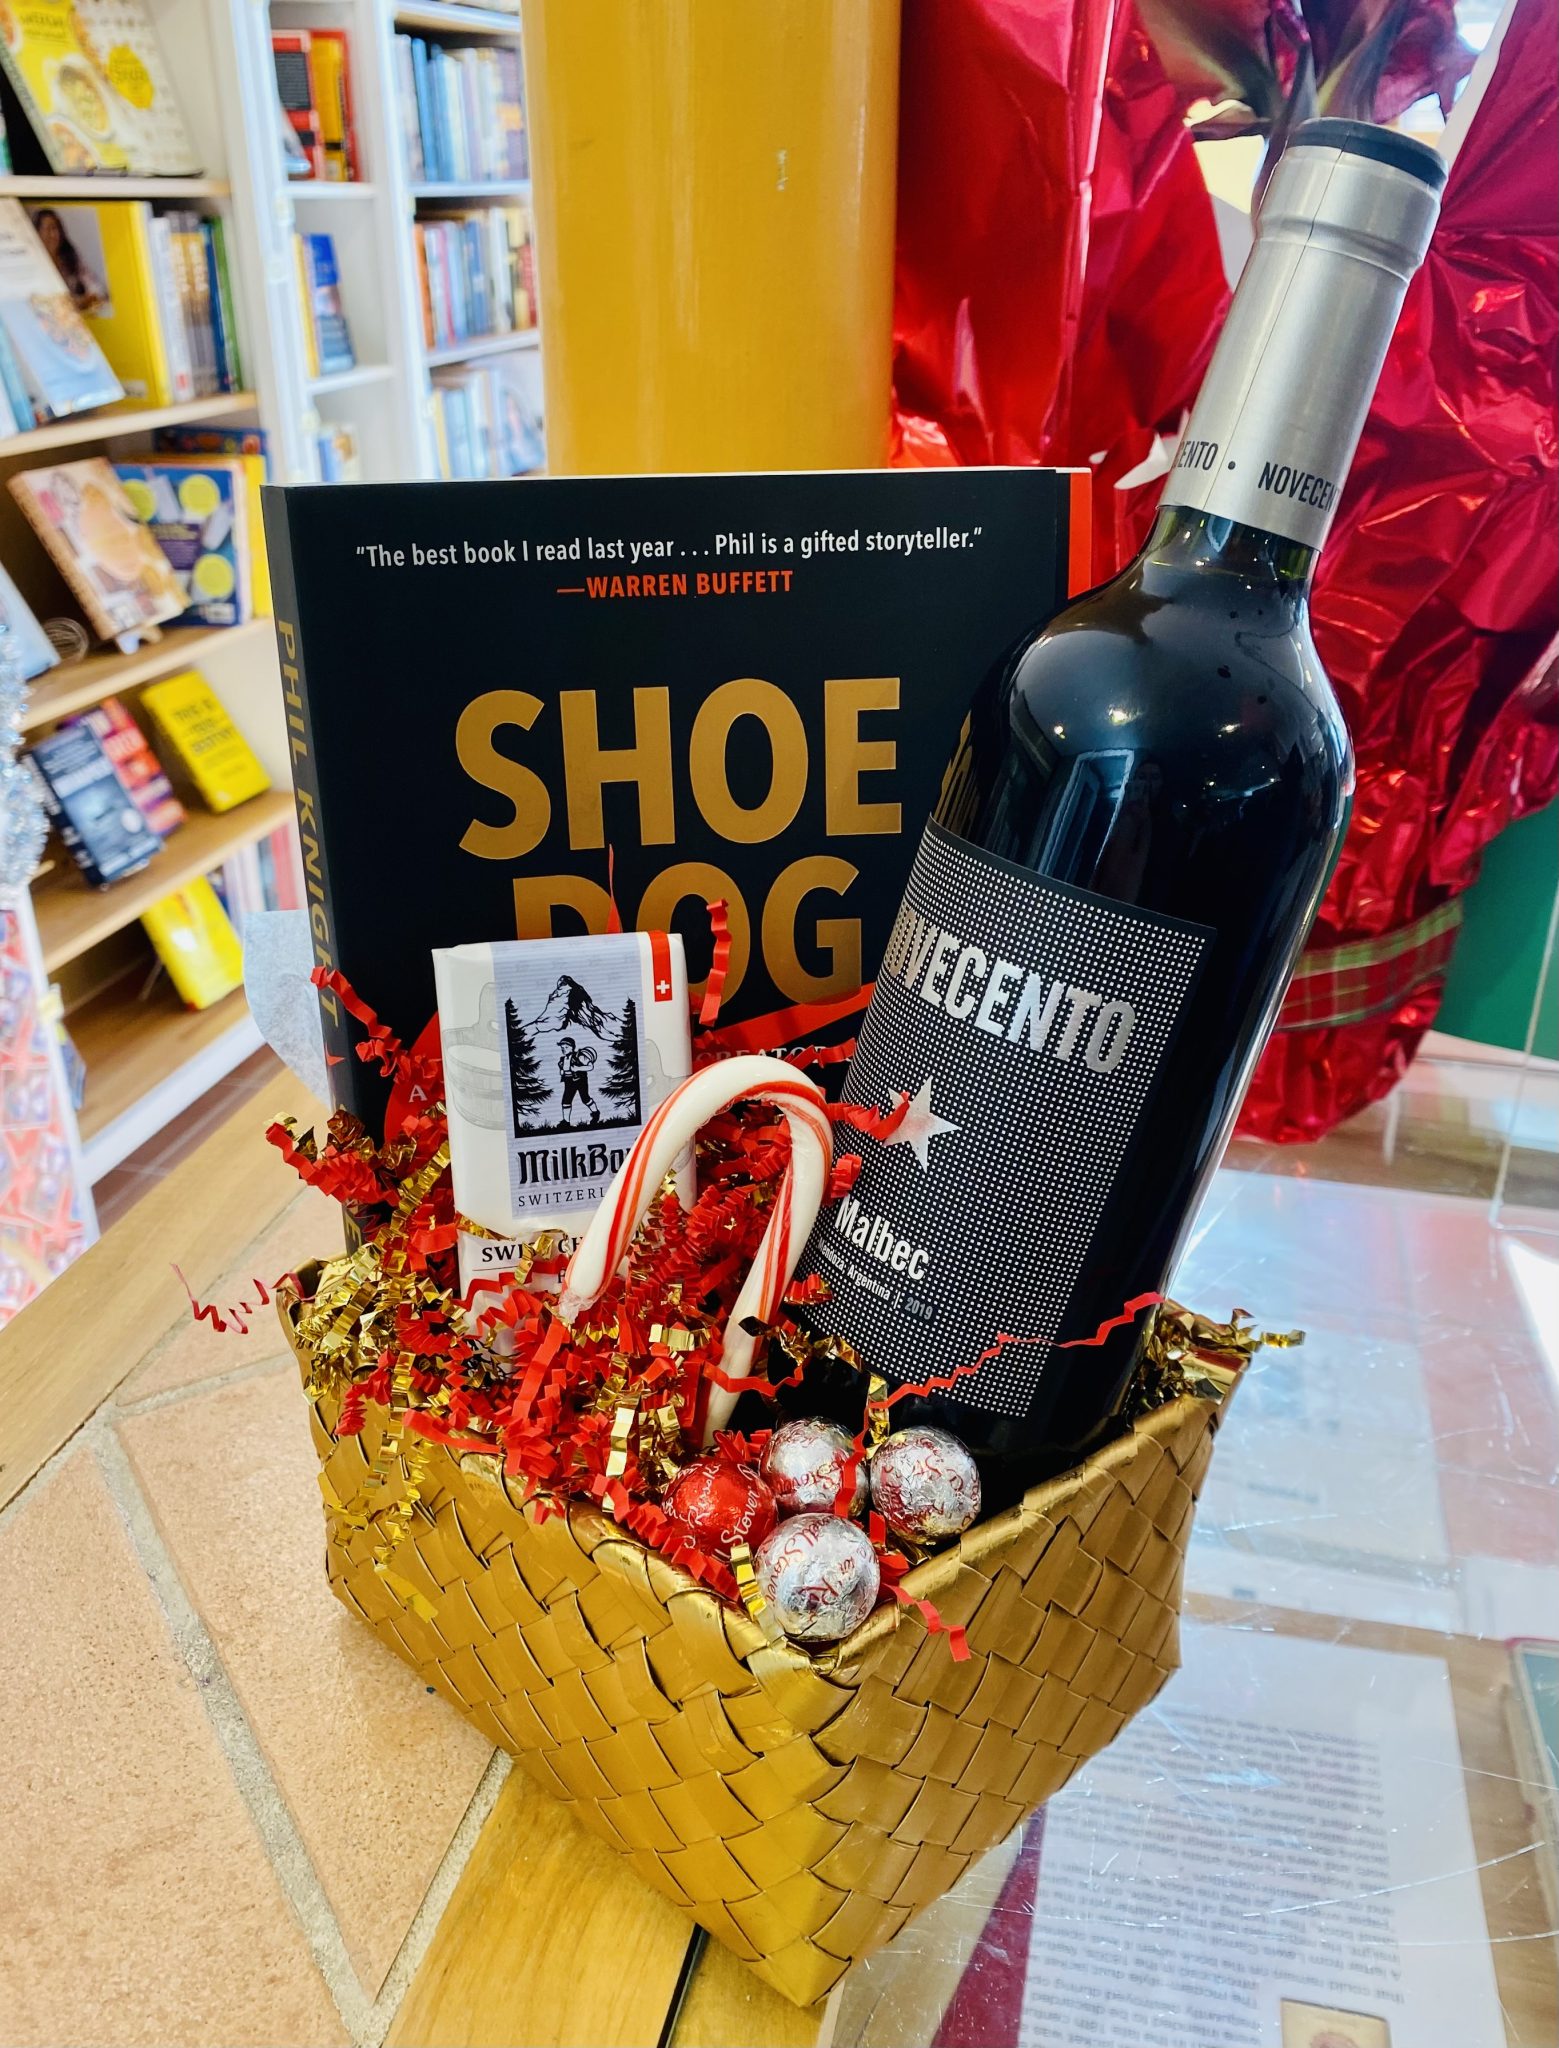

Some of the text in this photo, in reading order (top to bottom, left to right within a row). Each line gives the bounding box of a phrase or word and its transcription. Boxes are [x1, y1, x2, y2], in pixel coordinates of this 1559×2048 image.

[1174, 441, 1218, 470] ENTO
[412, 543, 457, 566] best
[464, 540, 516, 564] book
[523, 540, 529, 561] I
[536, 537, 580, 560] read
[588, 537, 625, 559] last
[630, 539, 674, 564] year
[715, 532, 754, 555] Phil
[762, 532, 777, 554] is
[784, 535, 794, 553] a
[801, 529, 859, 559] gifted
[696, 570, 793, 595] BUFFETT
[278, 619, 308, 765] PHIL
[455, 677, 902, 860] SHOE
[409, 1084, 428, 1103] A
[517, 1143, 634, 1185] MilkBo
[518, 1187, 605, 1207] SWITZERL
[482, 1242, 537, 1263] SWI
[834, 1193, 930, 1280] Malbec
[847, 1264, 891, 1301] Argentina
[905, 1296, 934, 1320] 2019
[720, 1484, 762, 1545] Stover
